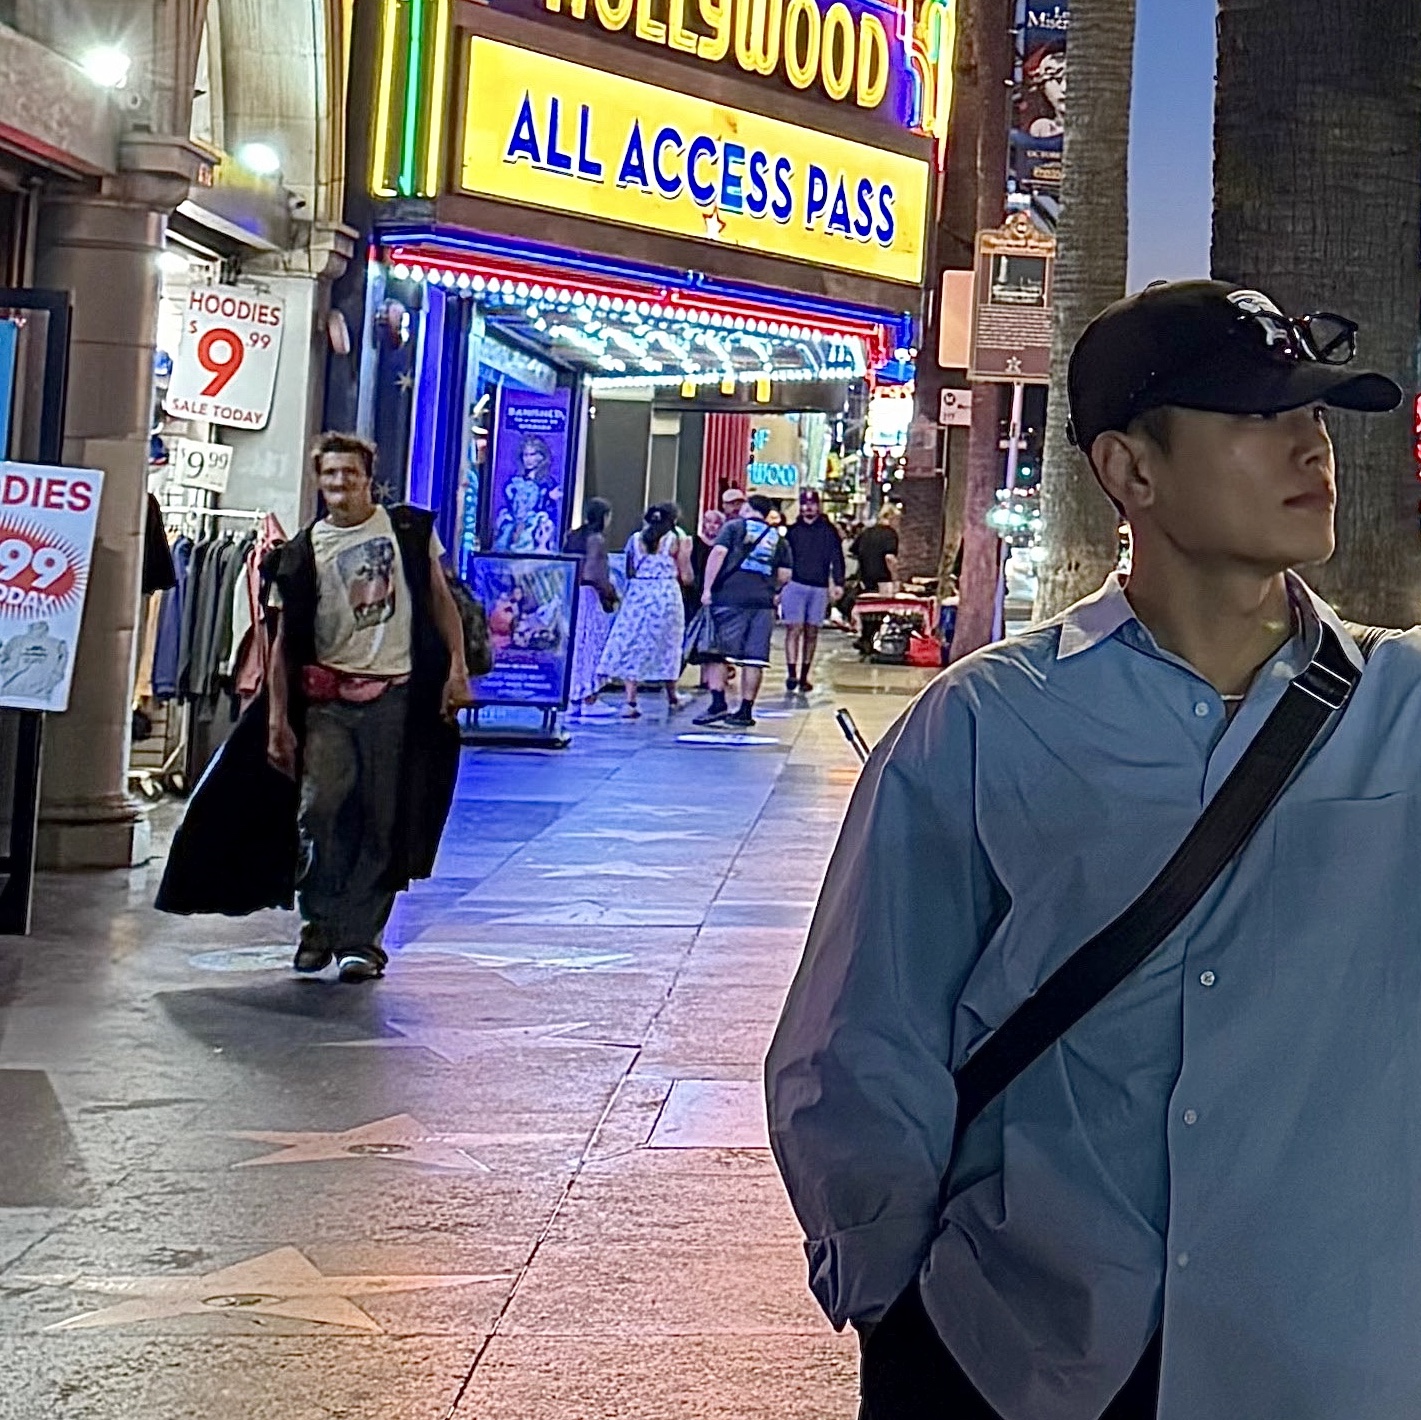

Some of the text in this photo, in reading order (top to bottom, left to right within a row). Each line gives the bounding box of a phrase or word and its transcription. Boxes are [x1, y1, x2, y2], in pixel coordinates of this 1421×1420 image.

[546, 0, 889, 107] LYWOOD
[507, 89, 896, 245] ALL ACCESS PASS
[189, 291, 281, 326] HOODIES
[172, 398, 264, 425] SALE TODAY
